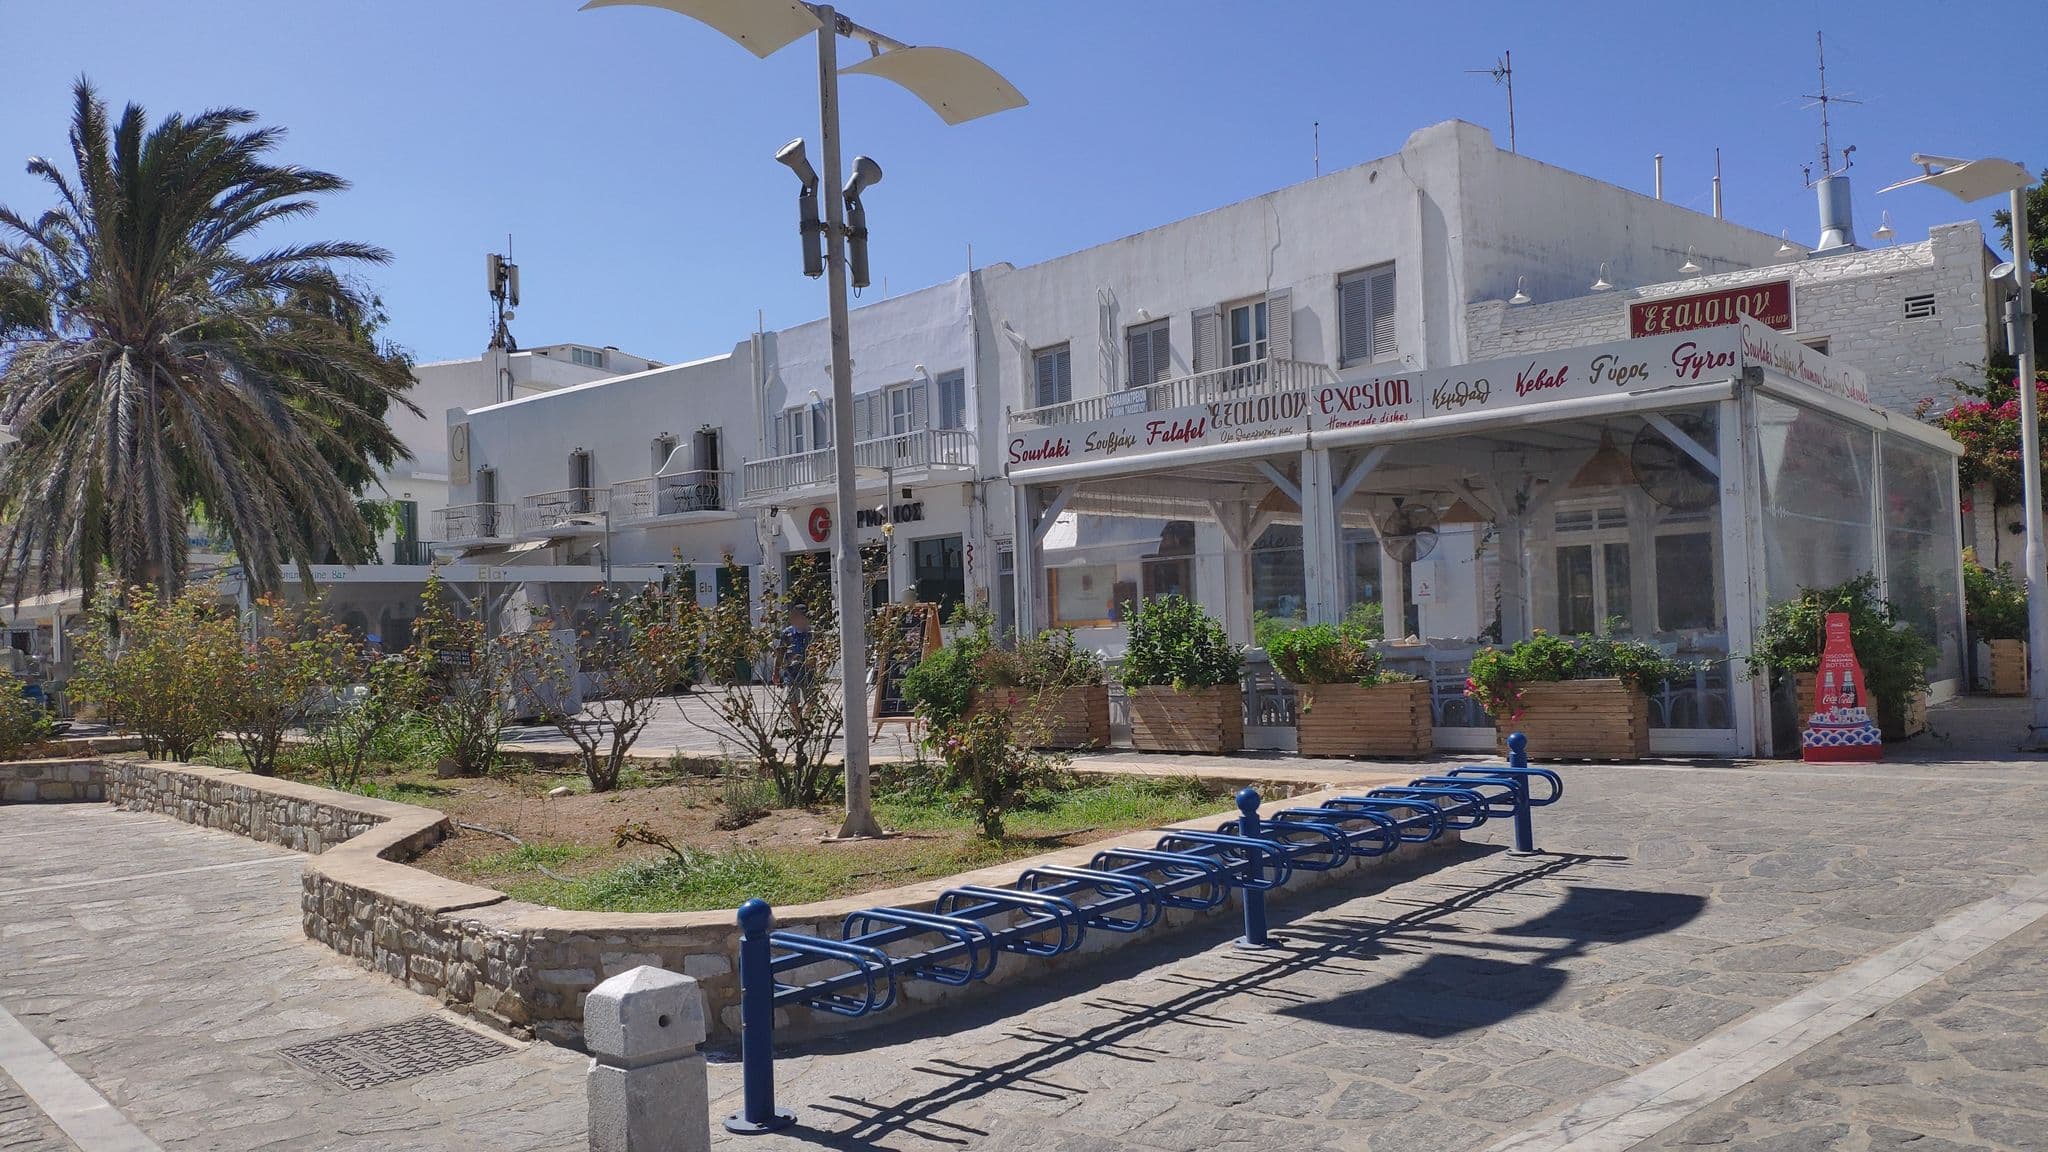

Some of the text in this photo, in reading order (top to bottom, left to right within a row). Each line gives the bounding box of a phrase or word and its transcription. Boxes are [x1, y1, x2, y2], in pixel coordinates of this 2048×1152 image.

[1589, 354, 1649, 386] Γύρος
[1671, 342, 1735, 379] Gyros
[1515, 361, 1569, 397] Kebab
[1314, 378, 1412, 414] exesion
[1146, 417, 1206, 446] Falafel
[1326, 410, 1409, 430] Homemade dishes
[1009, 438, 1070, 464] Souvlaki
[332, 571, 346, 579] Bar
